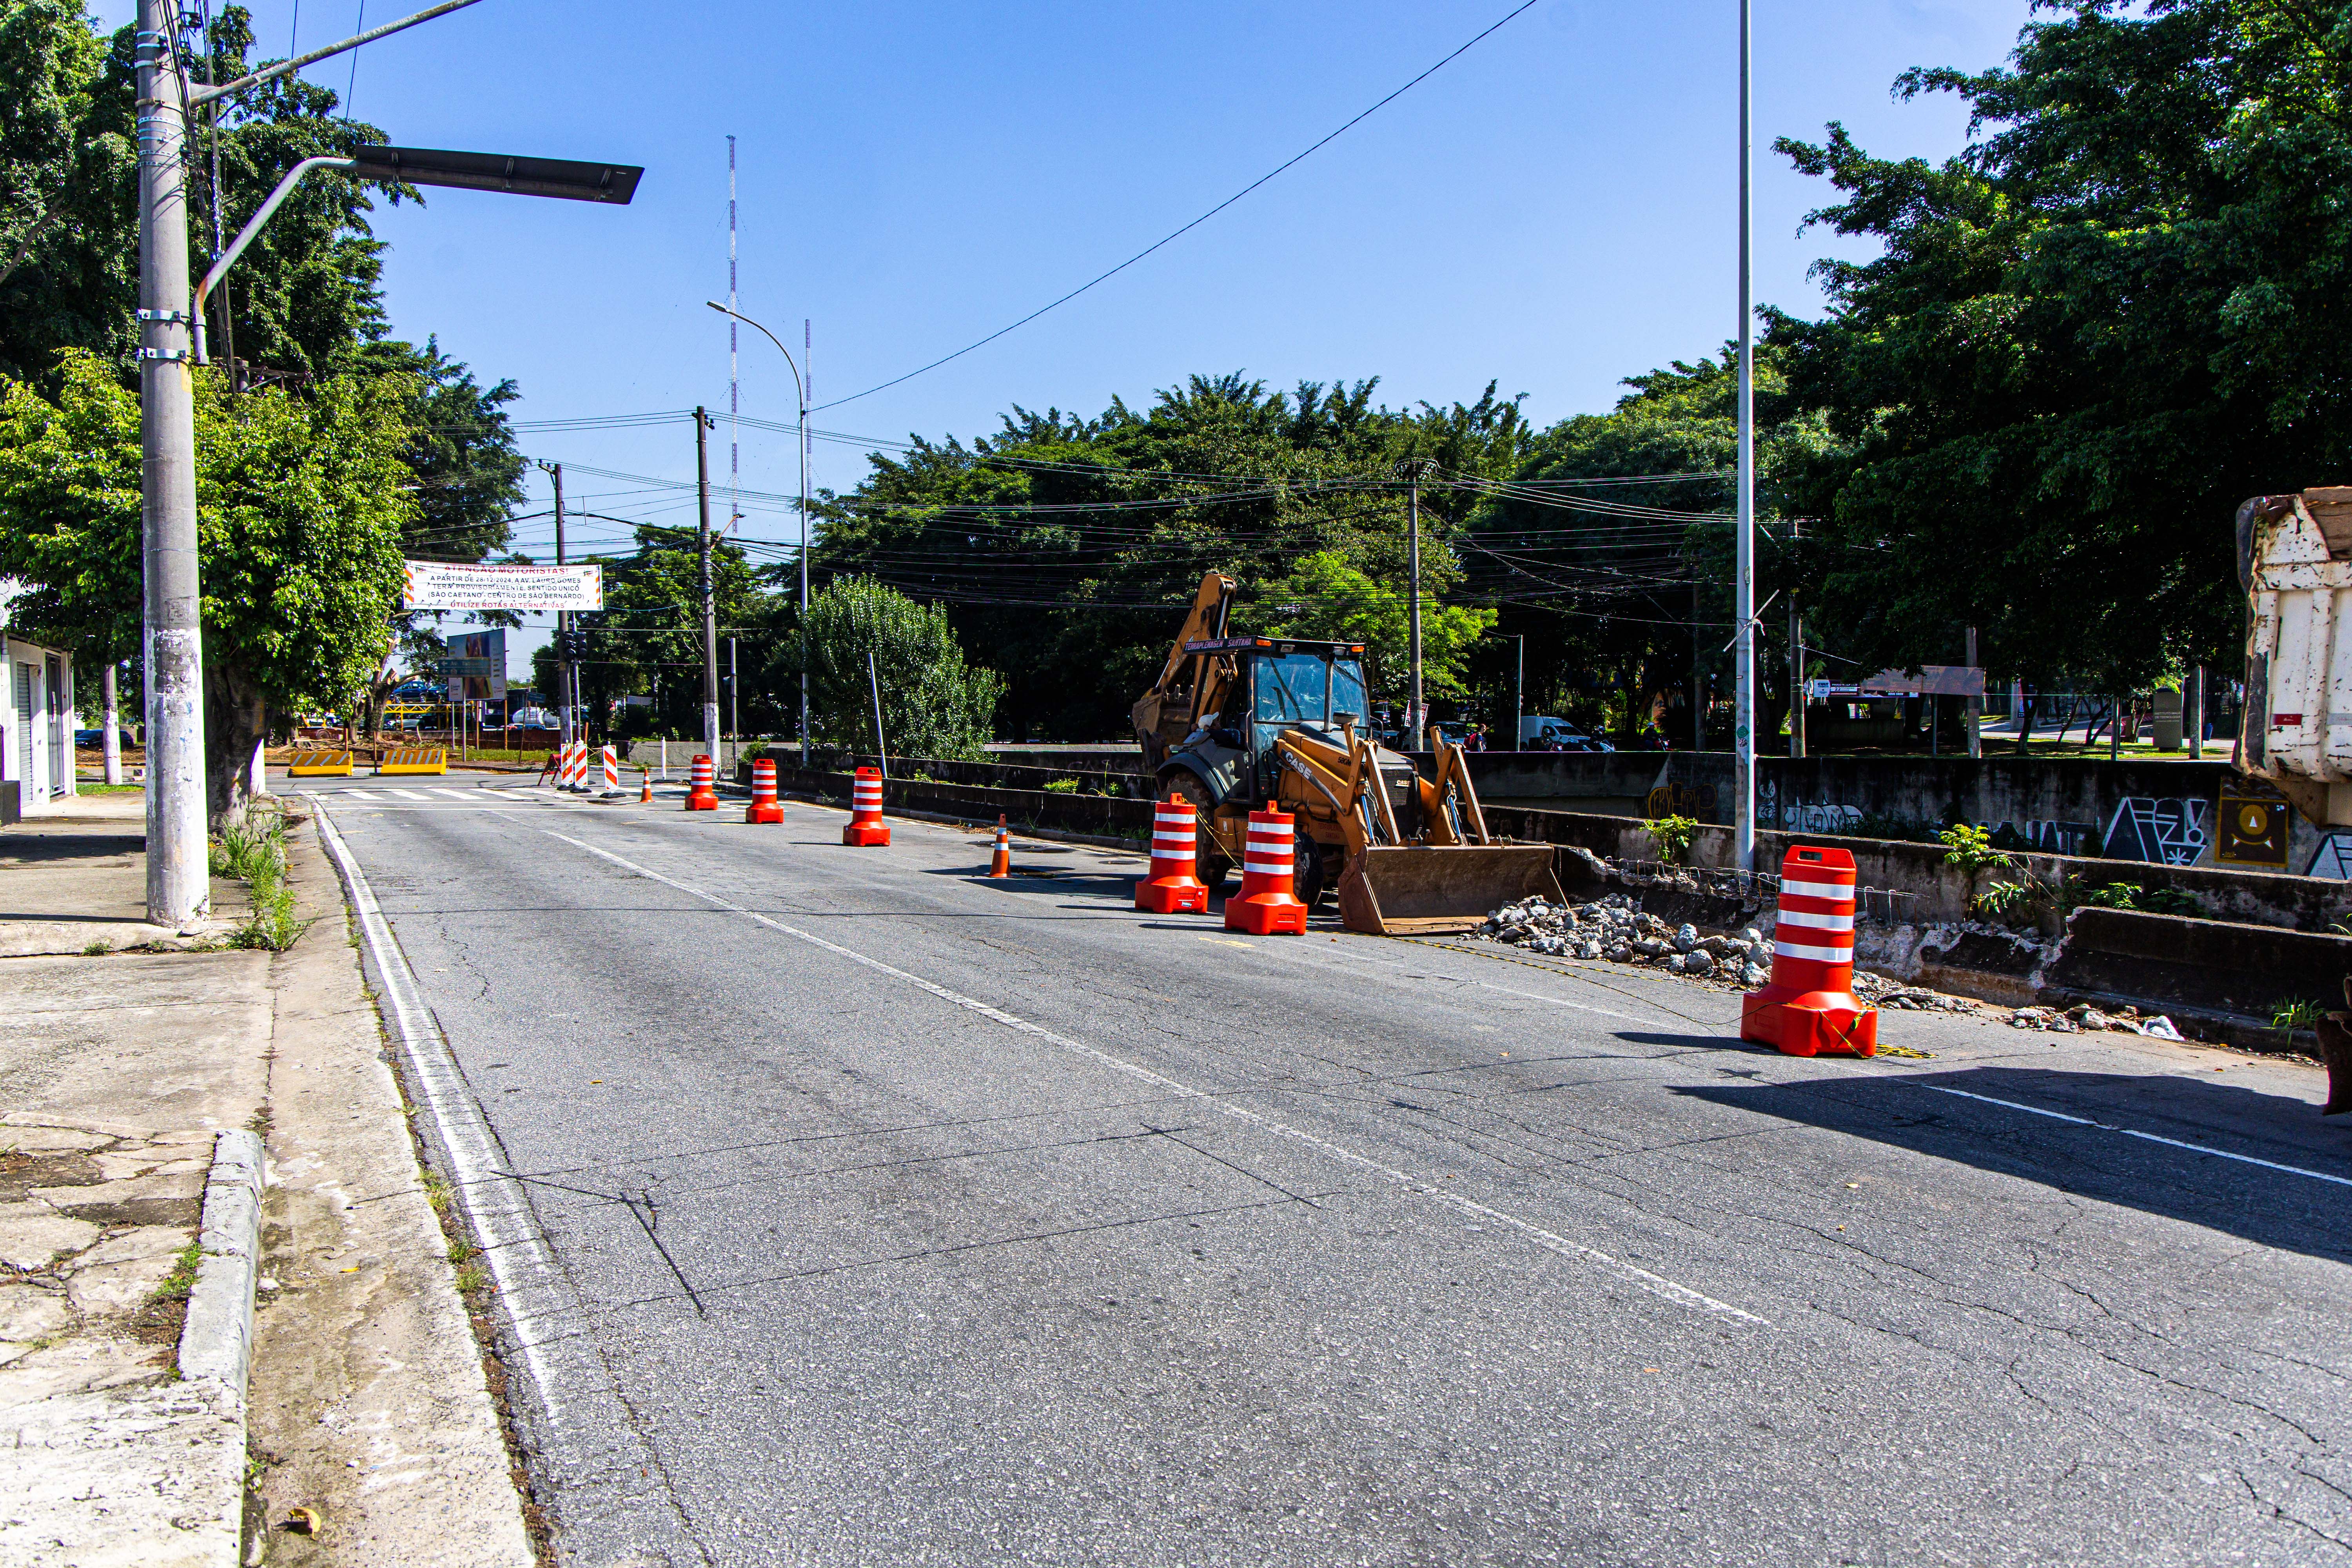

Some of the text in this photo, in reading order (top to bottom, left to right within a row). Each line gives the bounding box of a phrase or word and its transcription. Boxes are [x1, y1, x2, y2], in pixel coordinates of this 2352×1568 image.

[1185, 638, 1252, 651] TERRAPLENAGEM SANTANA
[1285, 751, 1312, 780] CASE
